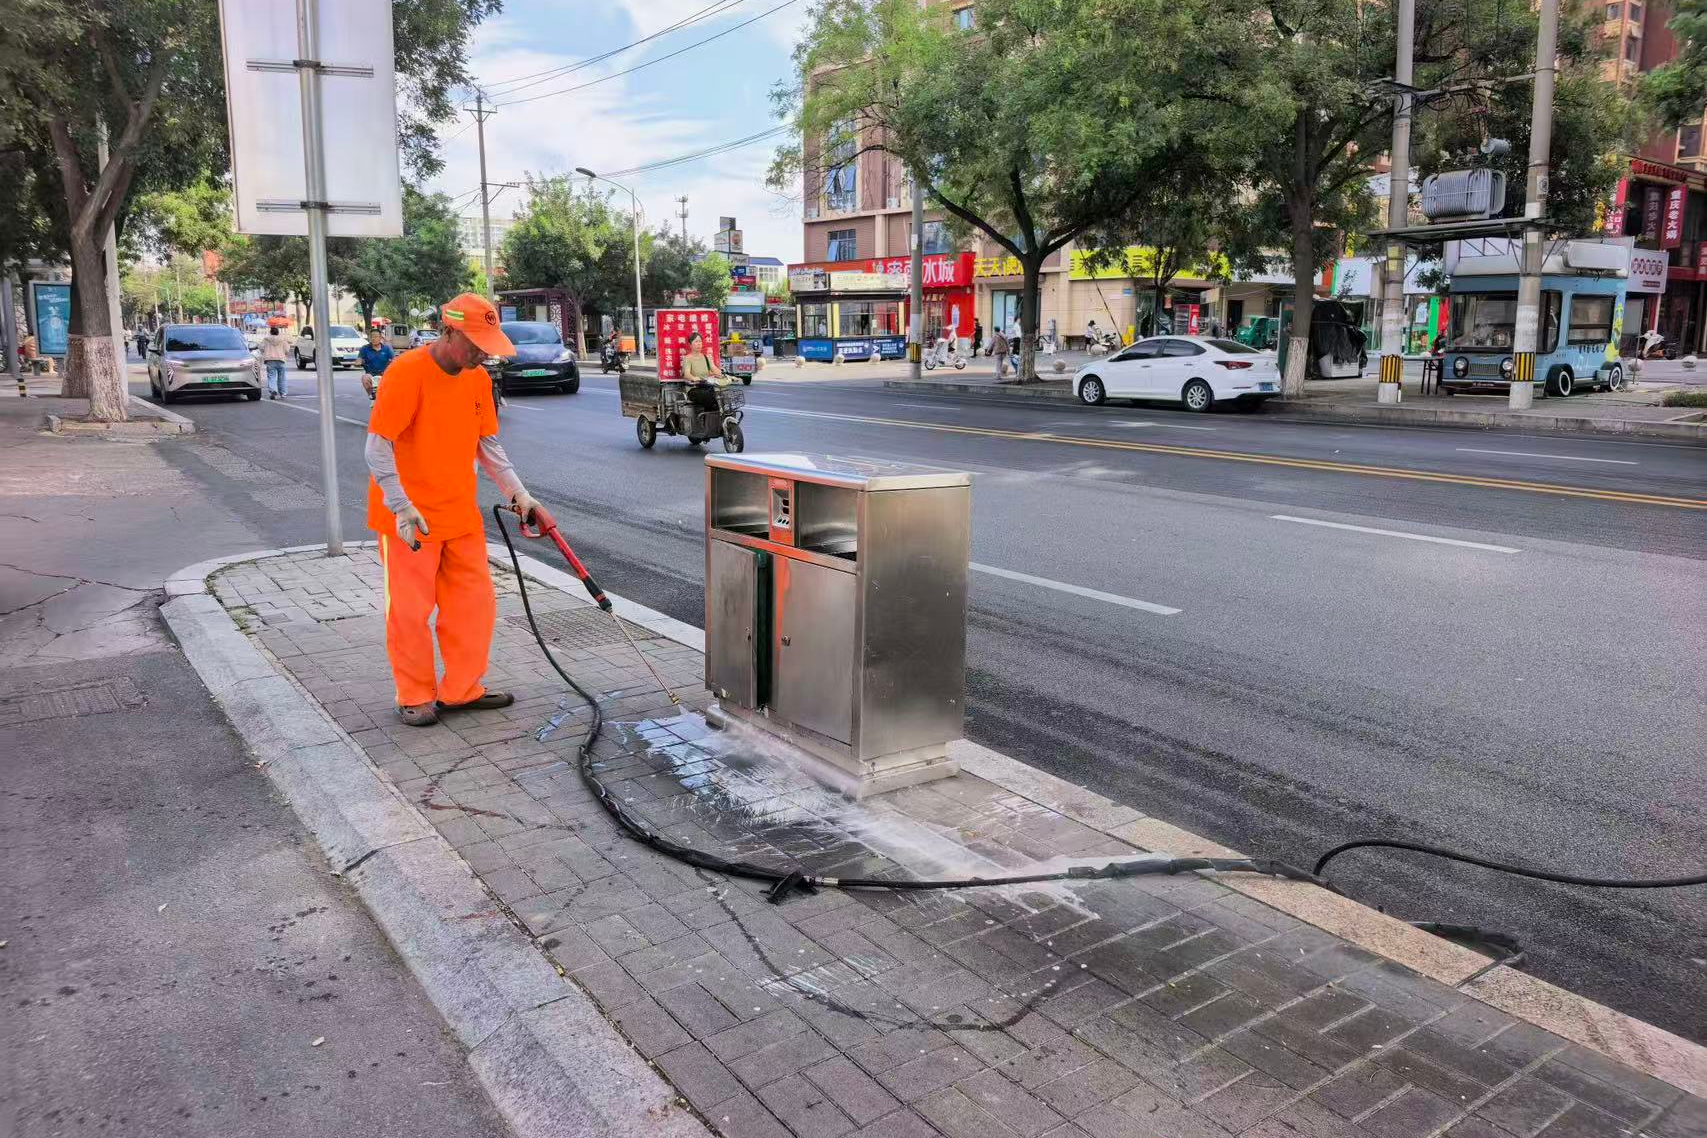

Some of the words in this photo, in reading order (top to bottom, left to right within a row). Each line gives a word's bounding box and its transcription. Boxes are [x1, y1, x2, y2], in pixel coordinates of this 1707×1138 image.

[1666, 190, 1682, 240] 重庆老火锅
